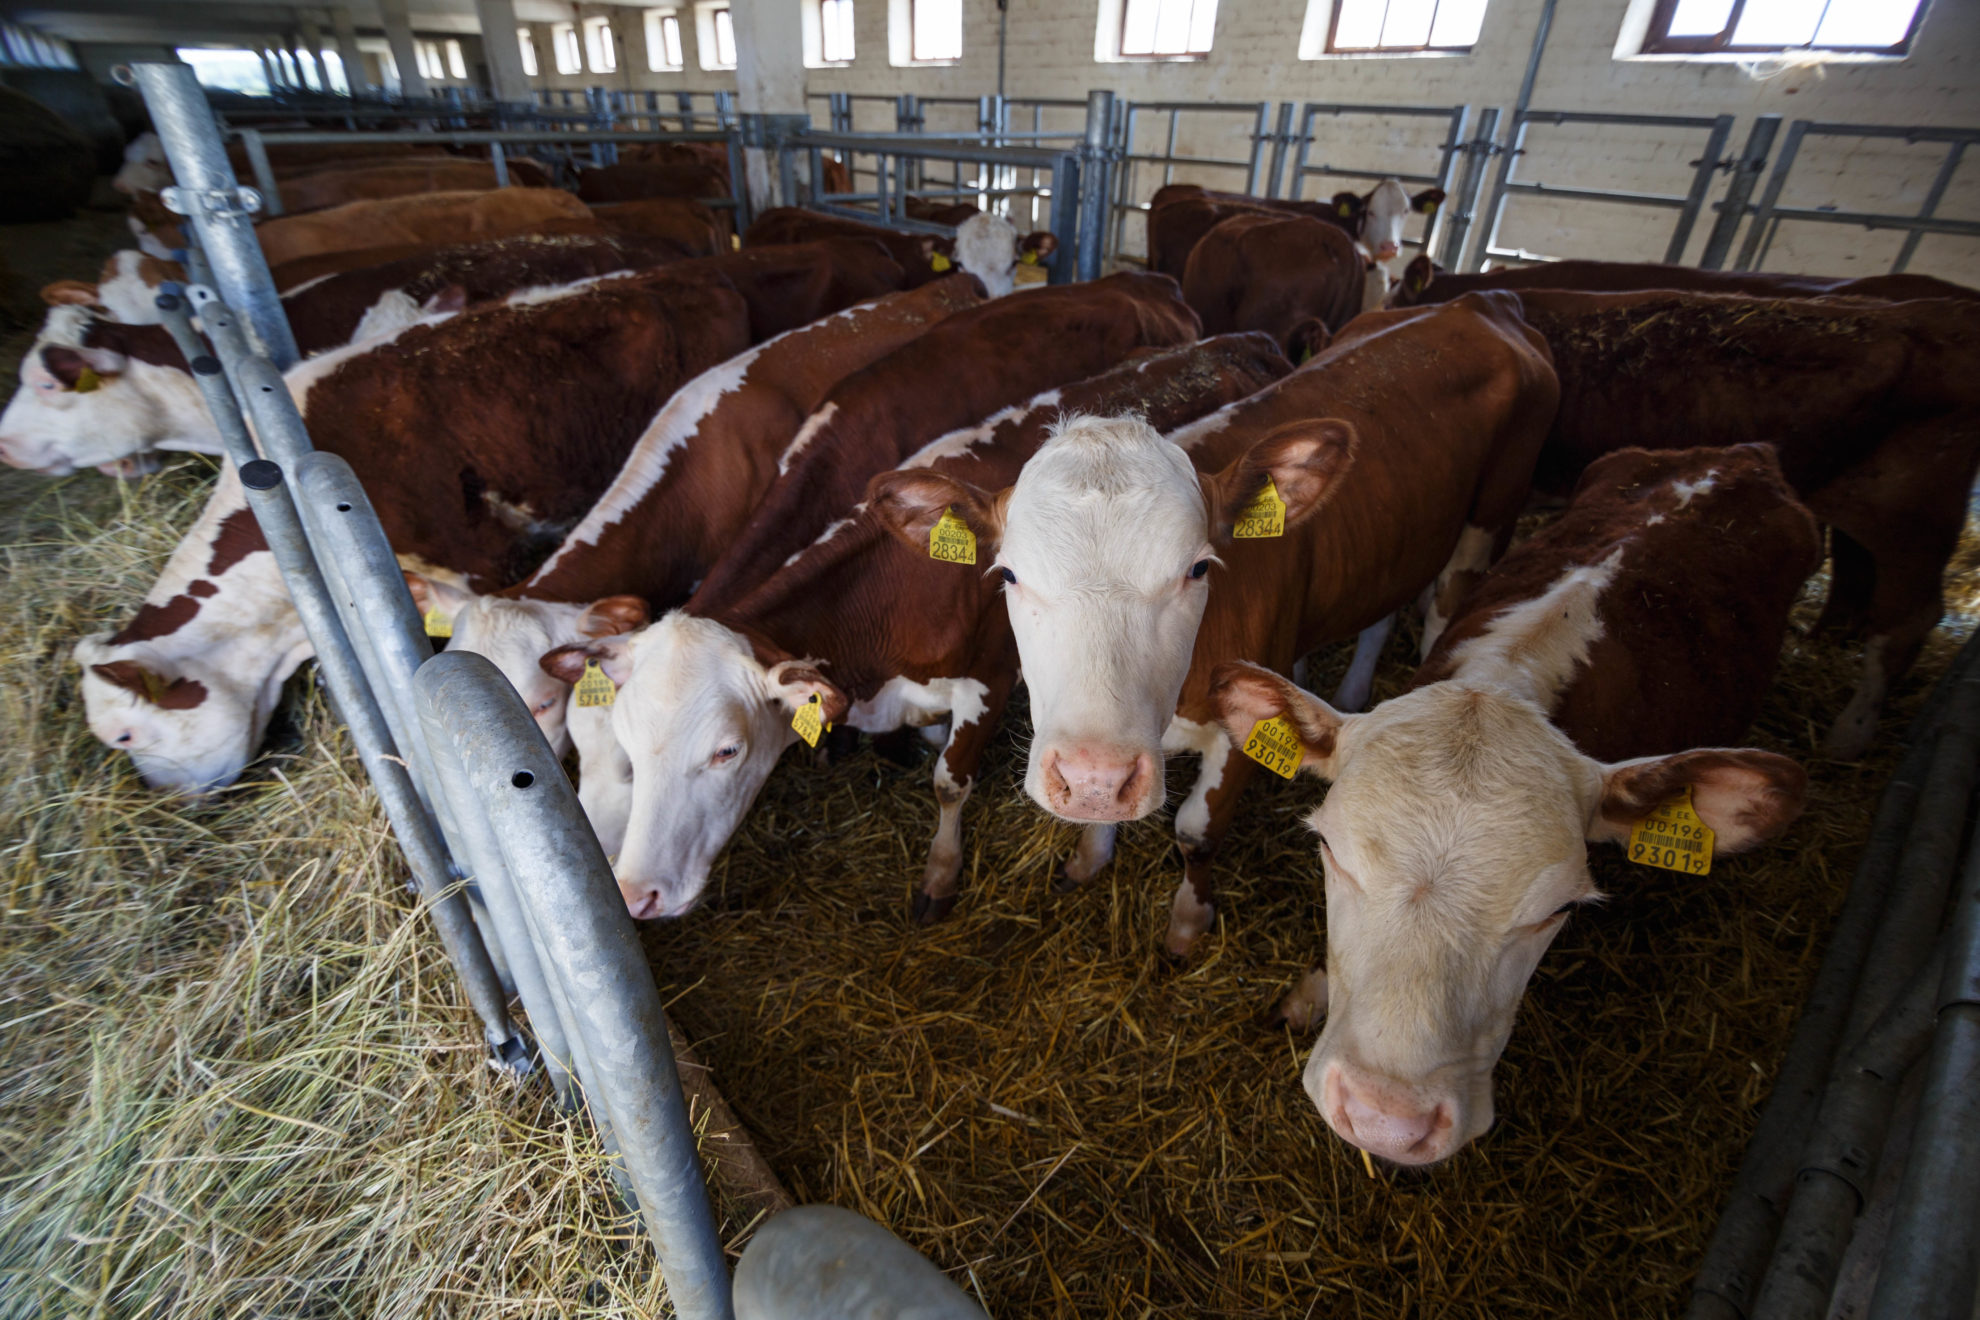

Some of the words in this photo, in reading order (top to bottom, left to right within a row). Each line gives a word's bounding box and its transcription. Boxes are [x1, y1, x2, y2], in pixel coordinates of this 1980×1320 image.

[939, 529, 967, 539] 00203
[1236, 519, 1281, 537] 28344
[932, 541, 974, 563] 28344
[1262, 722, 1298, 750] 00196
[1246, 739, 1291, 775] 93019
[1677, 811, 1690, 819] EE
[1645, 820, 1703, 839] 00196
[1633, 843, 1705, 873] 93019
